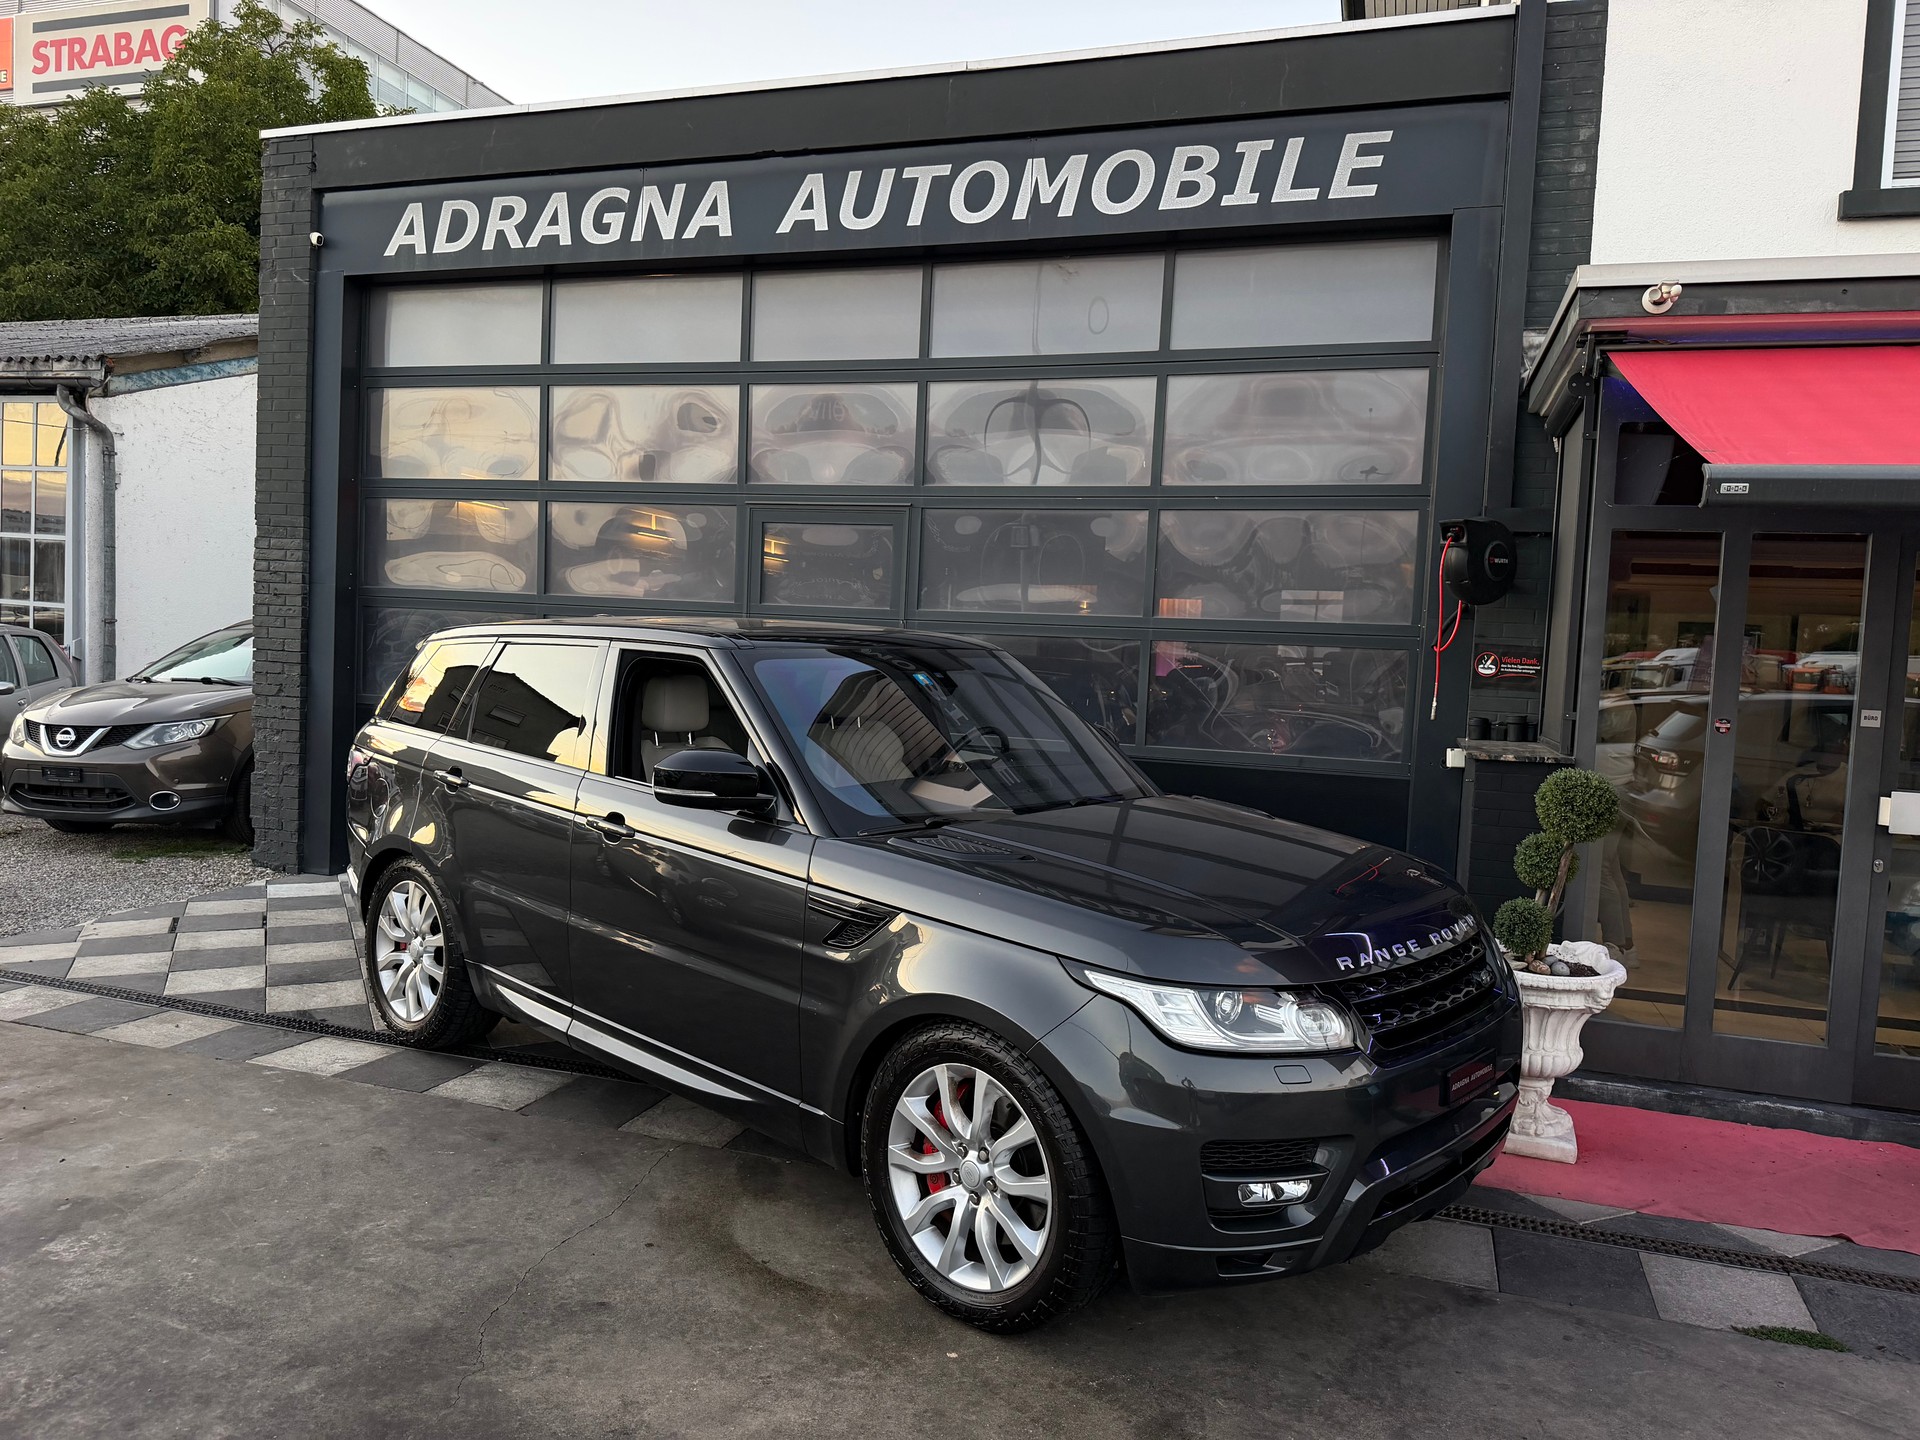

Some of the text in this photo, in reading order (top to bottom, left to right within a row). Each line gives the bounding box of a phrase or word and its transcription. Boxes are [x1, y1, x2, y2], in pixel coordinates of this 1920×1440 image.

[31, 24, 188, 75] STRABAG
[383, 130, 1394, 258] ADRAGNA AUTOMOBILE
[1336, 938, 1421, 970] RANGE
